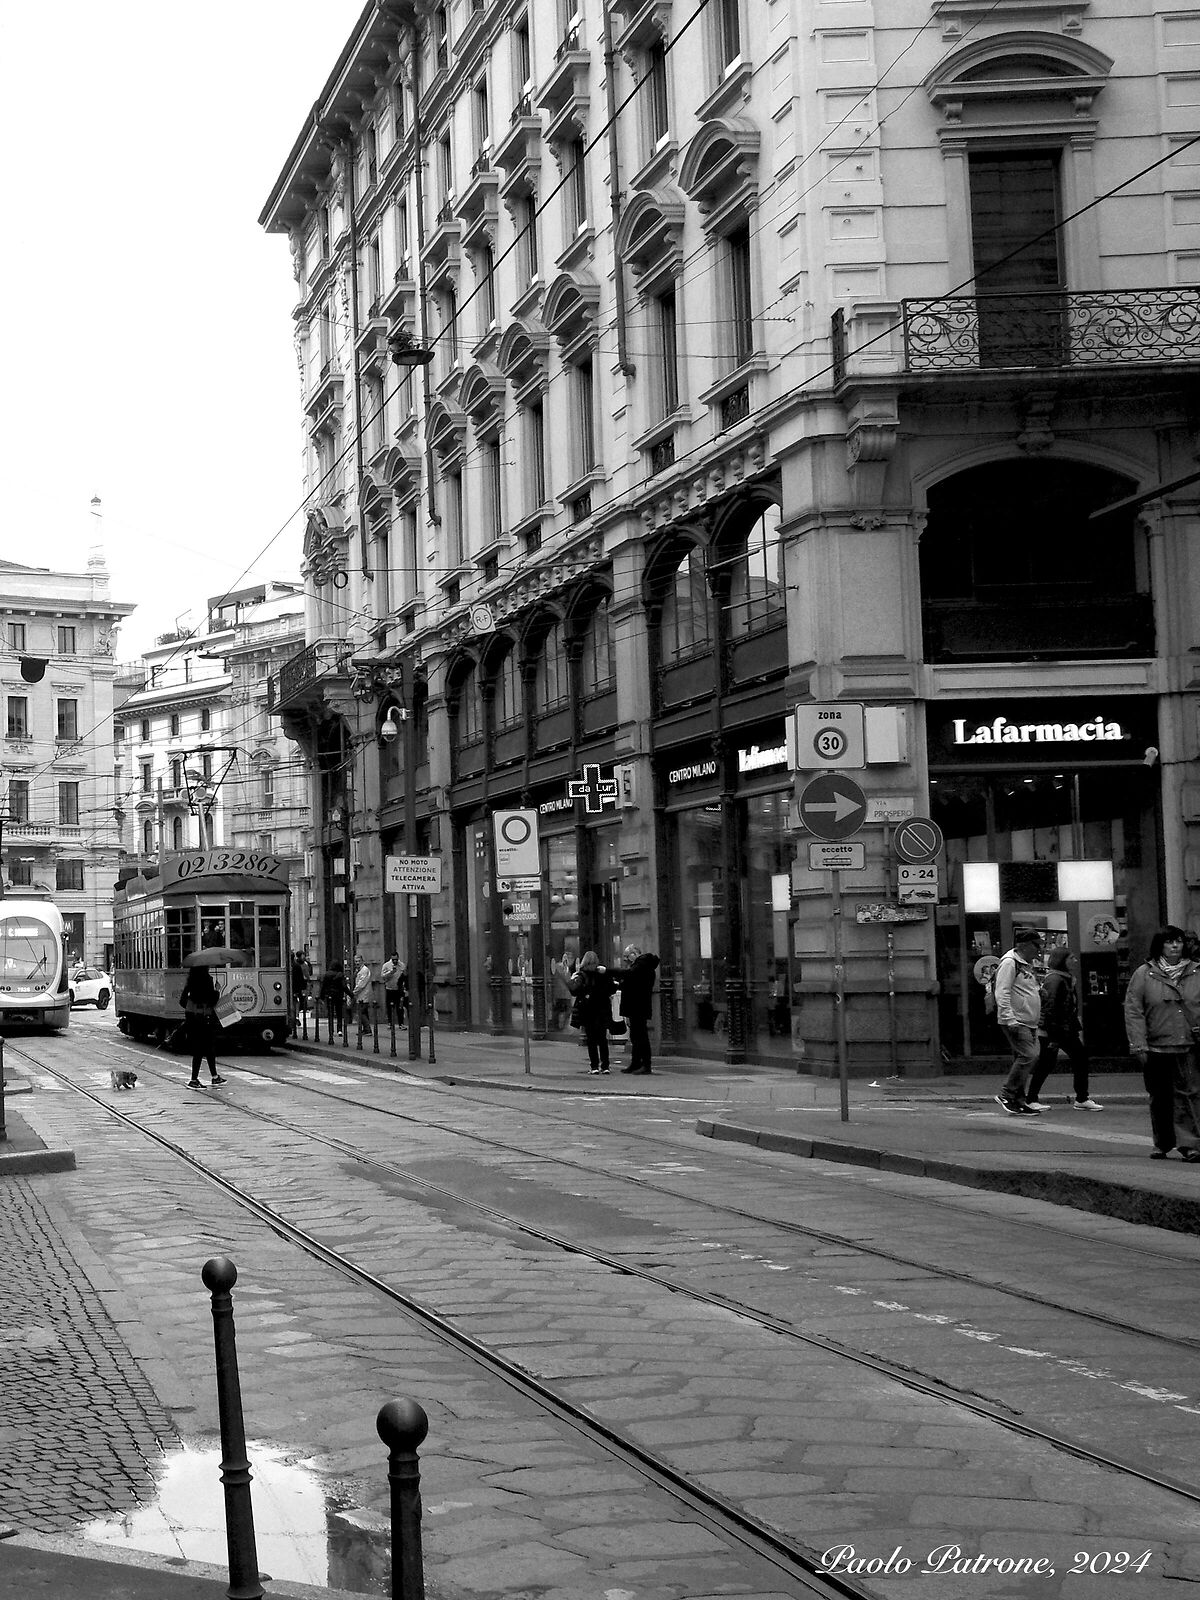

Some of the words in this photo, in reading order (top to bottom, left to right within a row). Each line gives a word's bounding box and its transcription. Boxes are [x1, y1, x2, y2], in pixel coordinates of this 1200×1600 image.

[818, 711, 842, 720] zona
[822, 736, 840, 750] 30
[669, 767, 692, 783] CENTRO
[692, 761, 716, 778] MILANO
[578, 785, 591, 793] da
[540, 800, 556, 814] CENTRO
[555, 798, 573, 811] MILANO
[874, 810, 912, 818] PROSPERO
[919, 869, 935, 879] 24
[511, 903, 531, 913] TRAM
